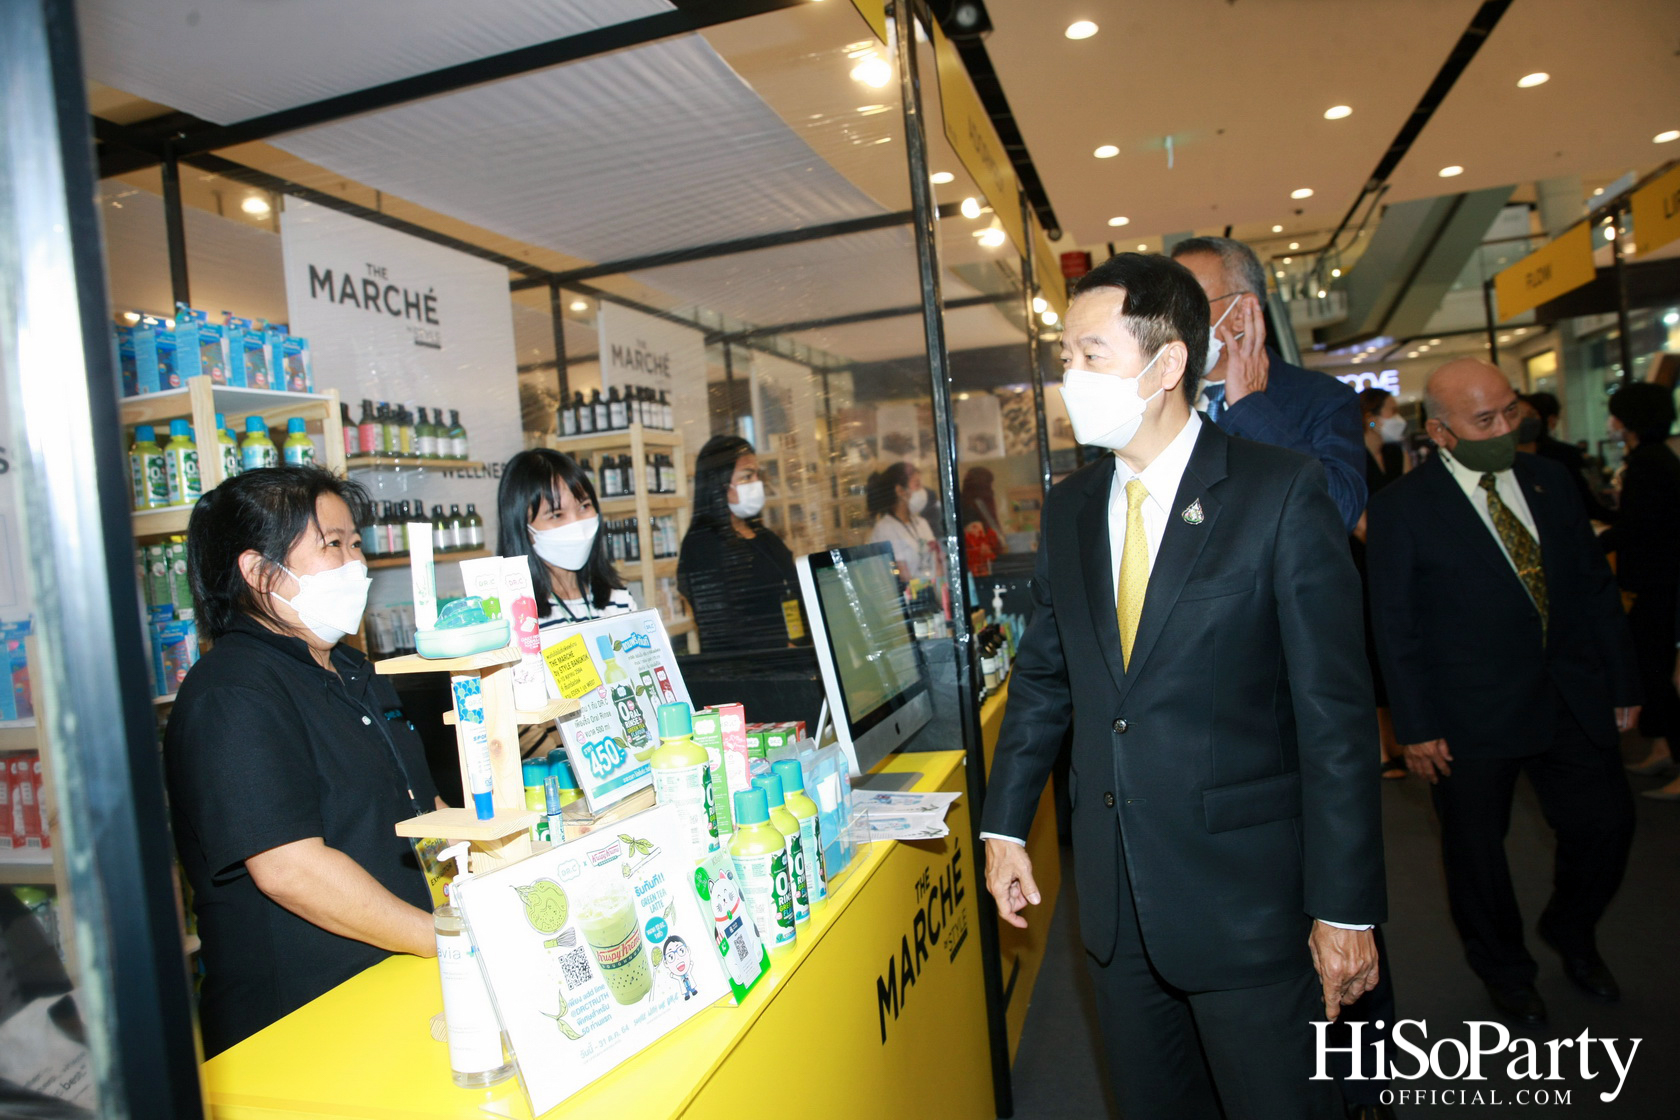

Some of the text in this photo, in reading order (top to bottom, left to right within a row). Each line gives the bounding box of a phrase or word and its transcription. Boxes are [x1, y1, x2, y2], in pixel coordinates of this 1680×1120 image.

[366, 262, 388, 281] THE
[308, 264, 440, 325] MARCHÉ
[610, 343, 671, 379] MARCHÉ
[595, 725, 605, 735] 500
[560, 865, 578, 877] DR.C
[915, 866, 930, 904] THE
[641, 891, 657, 908] GREEN
[649, 901, 665, 914] LATTE
[948, 908, 968, 952] STYLE
[877, 837, 965, 1046] MARCHÉ
[583, 989, 594, 1000] add
[595, 984, 605, 995] line
[571, 993, 609, 1017] @DRCTRUTH
[582, 1026, 591, 1036] 50
[599, 1038, 607, 1048] 31
